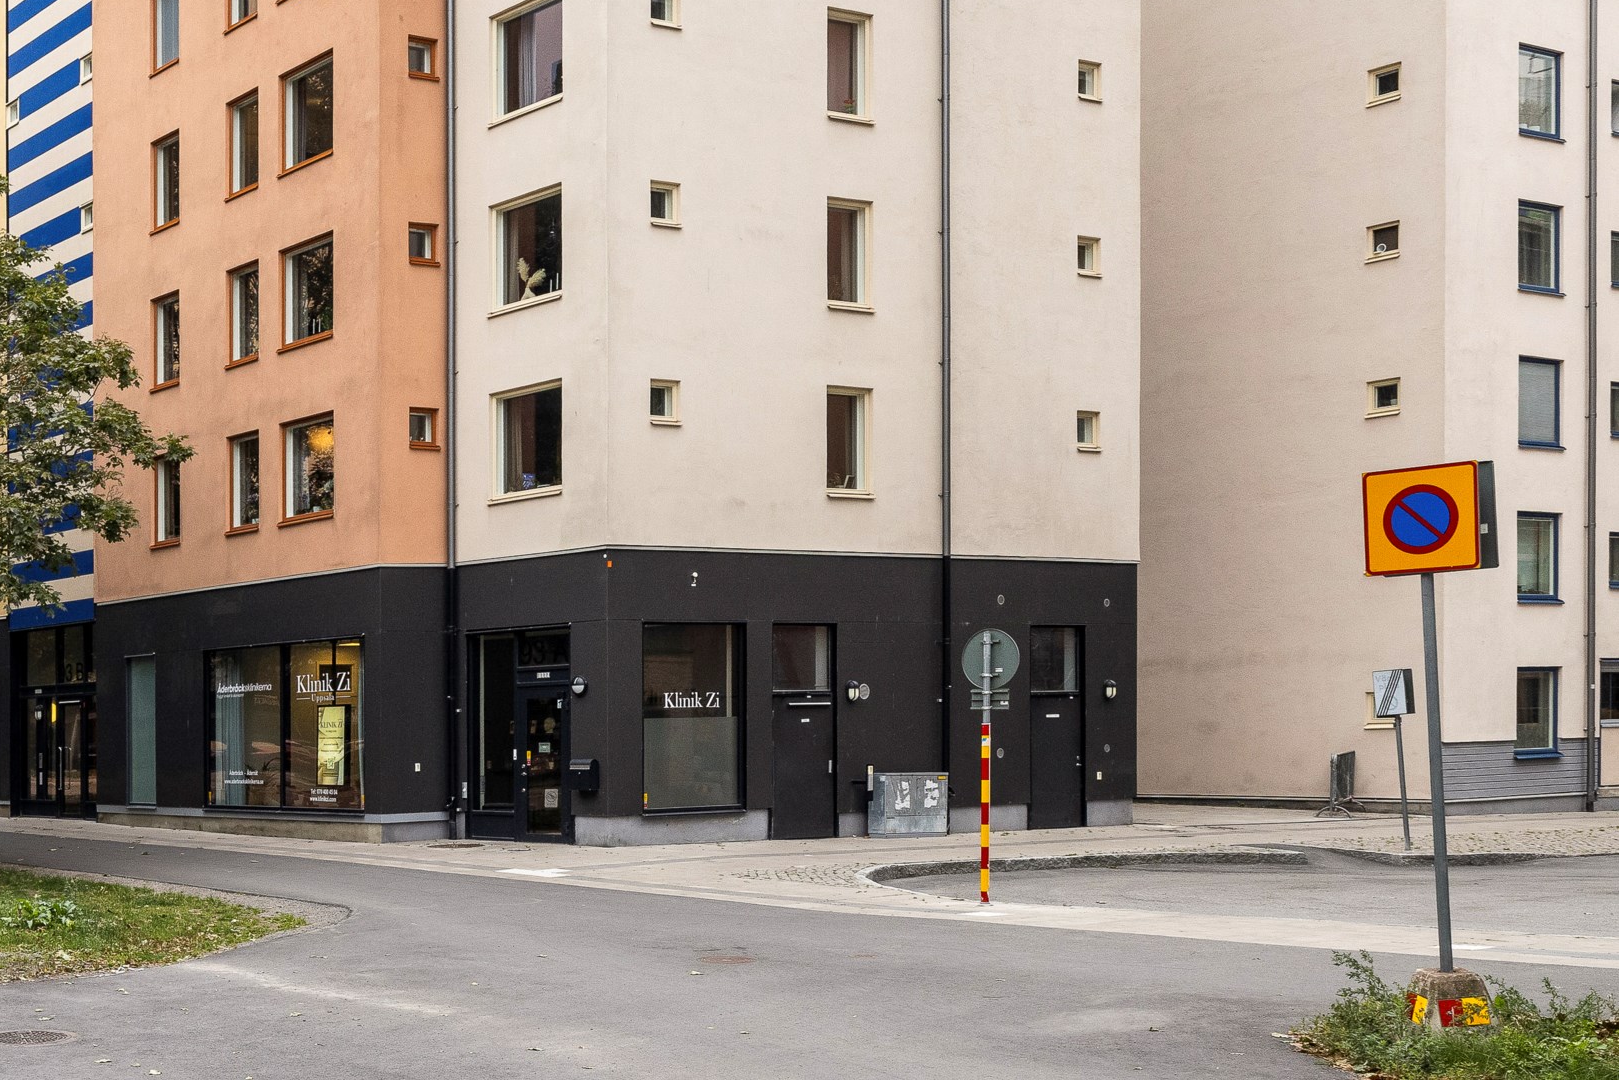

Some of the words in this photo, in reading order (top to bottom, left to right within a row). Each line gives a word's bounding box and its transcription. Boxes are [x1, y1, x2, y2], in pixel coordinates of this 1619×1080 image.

[296, 673, 335, 693] Klinik
[336, 671, 351, 691] Zi
[311, 693, 335, 703] Uppsala
[663, 691, 703, 709] Klinik
[705, 691, 720, 708] Zi
